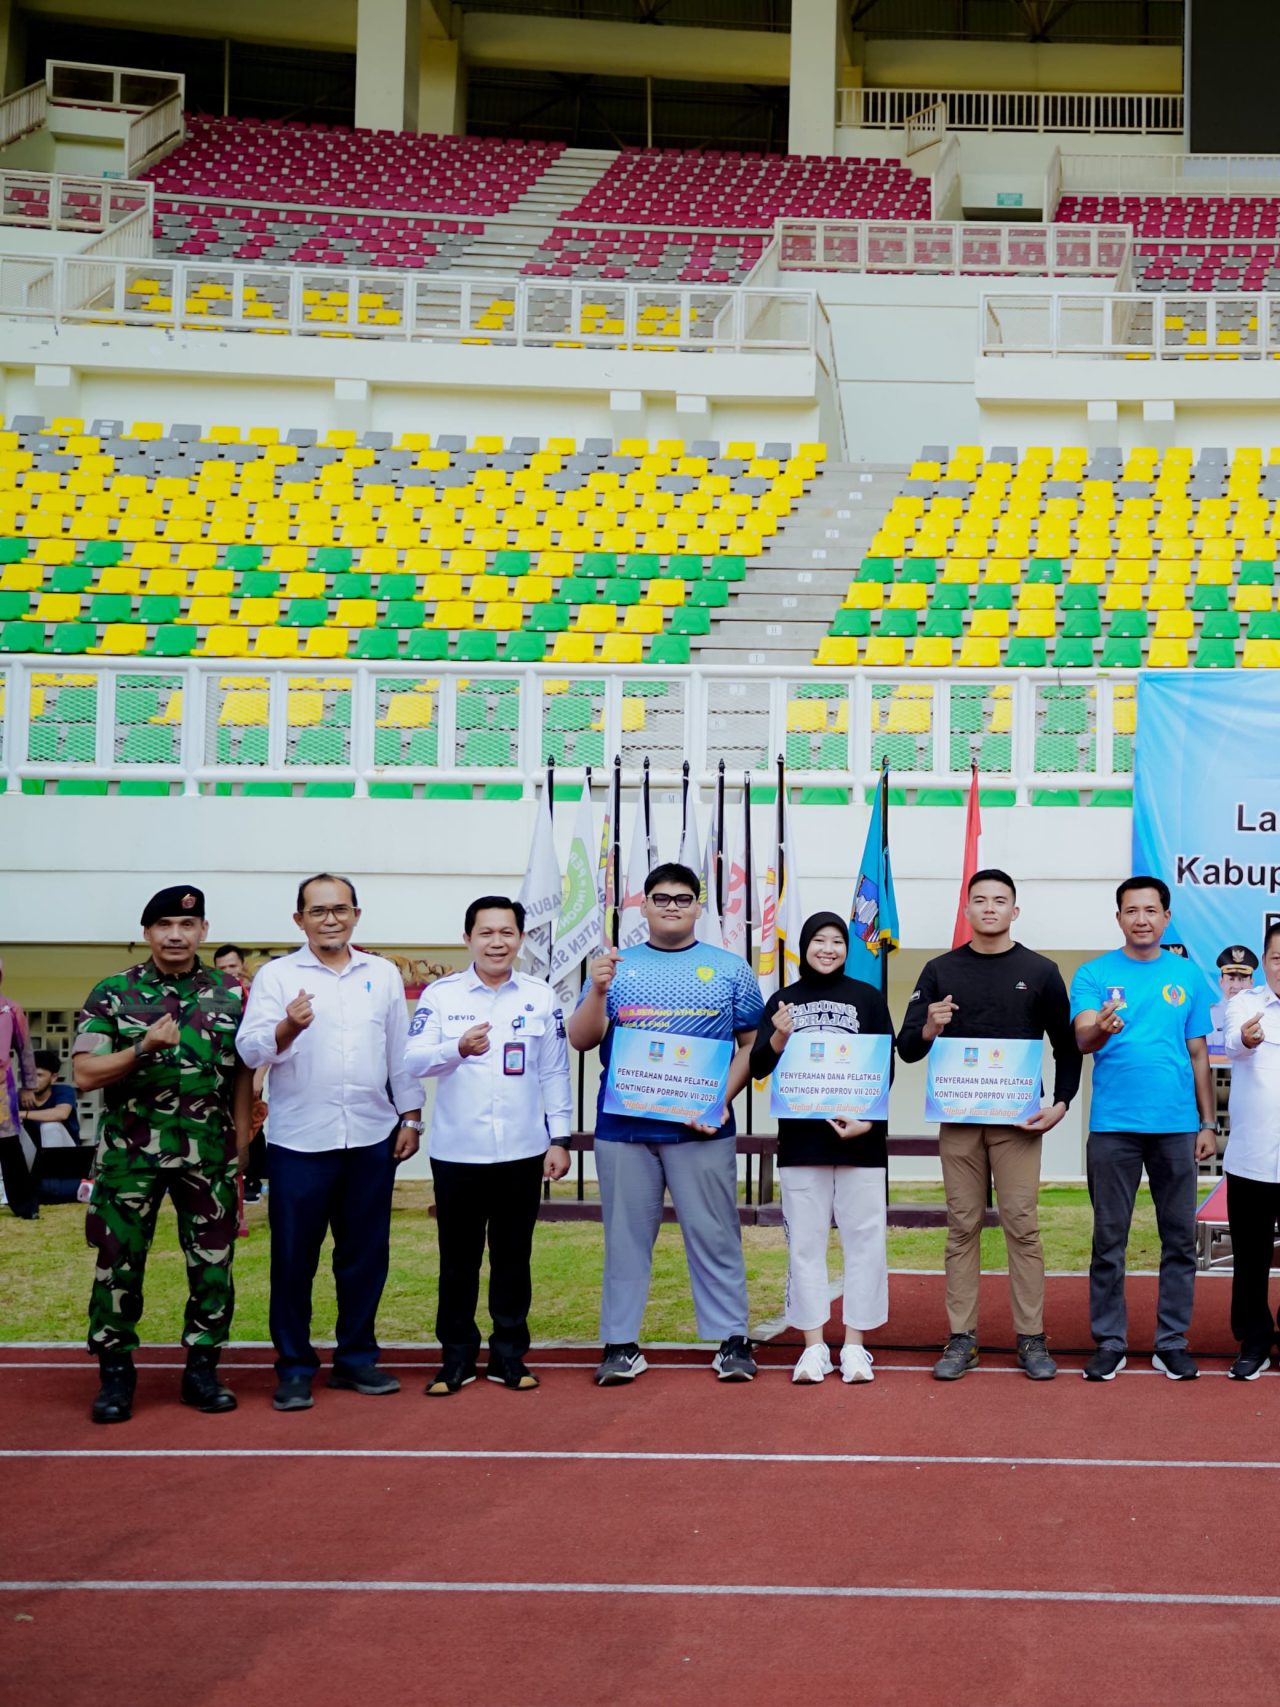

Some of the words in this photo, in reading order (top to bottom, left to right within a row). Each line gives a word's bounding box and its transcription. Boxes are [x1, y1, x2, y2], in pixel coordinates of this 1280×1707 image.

[617, 1068, 663, 1080] PENYERAHAN
[664, 1074, 683, 1084] DANA
[684, 1077, 719, 1088] PELATKAB
[780, 1072, 825, 1080] PENYERAHAN
[827, 1072, 845, 1080] DANA
[847, 1073, 881, 1081] PELATKAB
[935, 1076, 979, 1085] PENYERAHAN
[980, 1077, 998, 1085] DANA
[1000, 1078, 1033, 1086] PELATKAB
[615, 1083, 655, 1094] KONTINGEN
[657, 1088, 689, 1099] PORPROV
[780, 1086, 819, 1094] KONTINGEN
[821, 1087, 852, 1095] PORPROV
[934, 1091, 973, 1099] KONTINGEN
